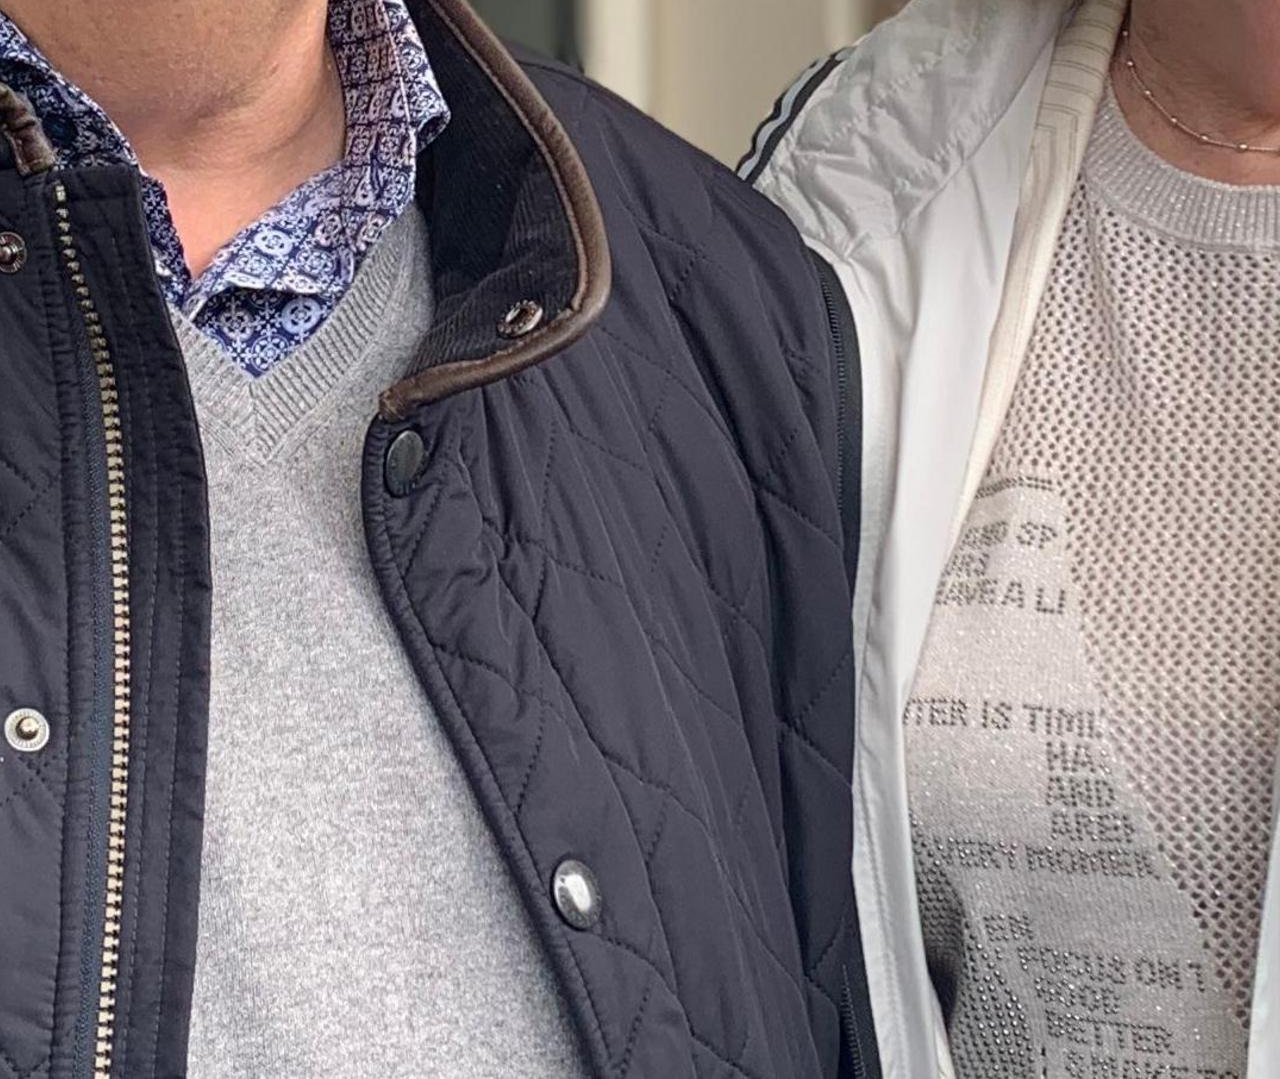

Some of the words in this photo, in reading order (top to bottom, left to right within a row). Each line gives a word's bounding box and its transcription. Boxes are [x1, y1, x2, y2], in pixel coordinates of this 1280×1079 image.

[981, 700, 1014, 730] IS
[1045, 776, 1116, 808] AND
[1044, 1008, 1176, 1056] BETTER
